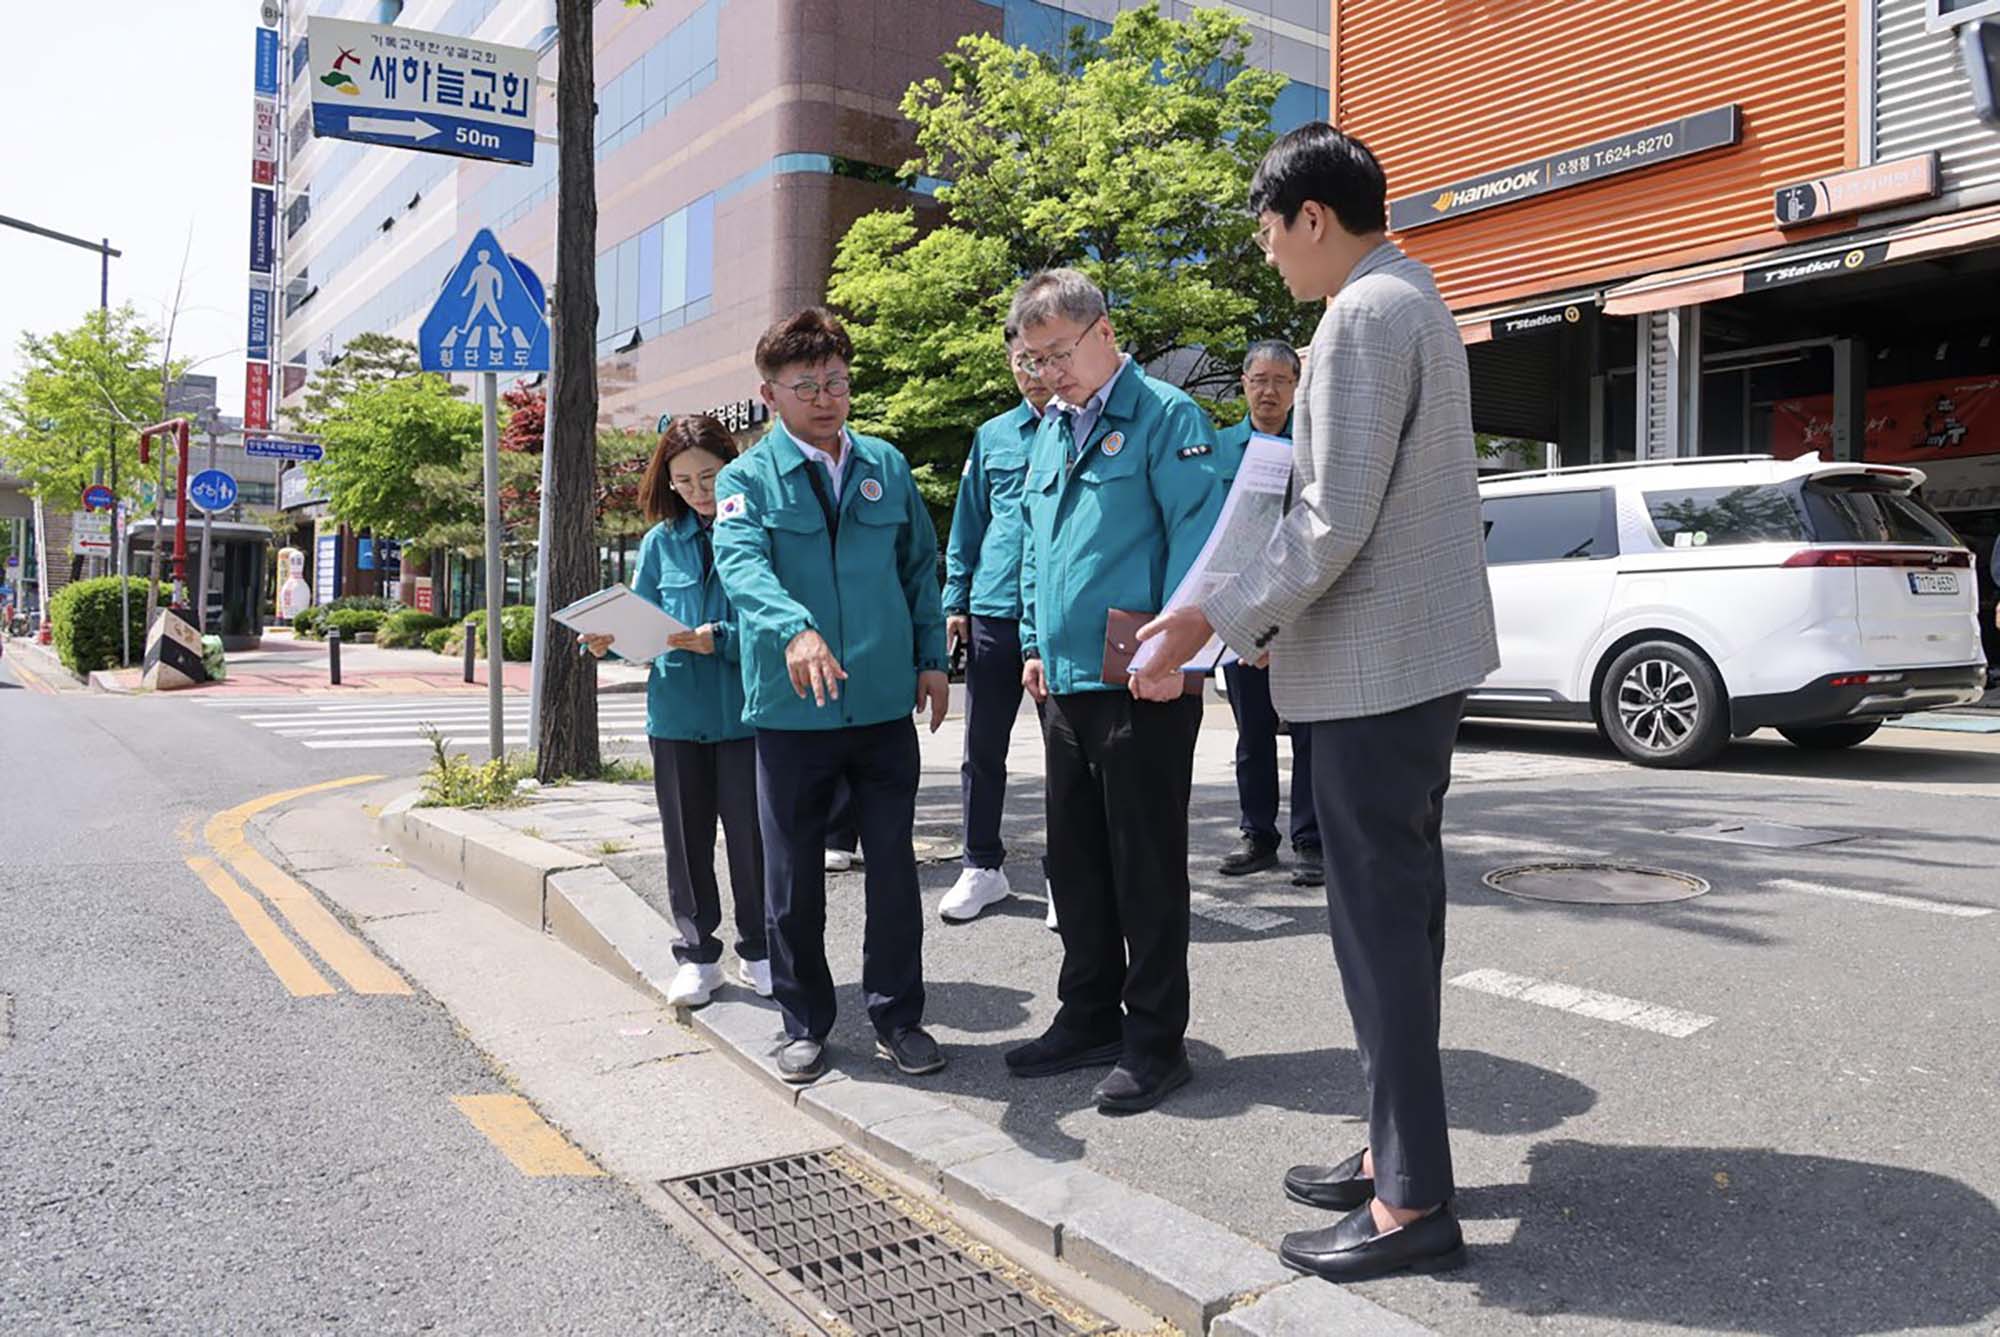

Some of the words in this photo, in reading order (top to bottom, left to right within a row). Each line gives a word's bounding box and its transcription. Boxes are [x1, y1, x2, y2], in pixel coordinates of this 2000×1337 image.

[369, 55, 529, 118] 새하늘교회
[455, 126, 500, 149] 50m
[1556, 155, 1591, 177] 오정점
[1594, 132, 1674, 168] T.624-8270
[440, 349, 529, 368] 횡단보도
